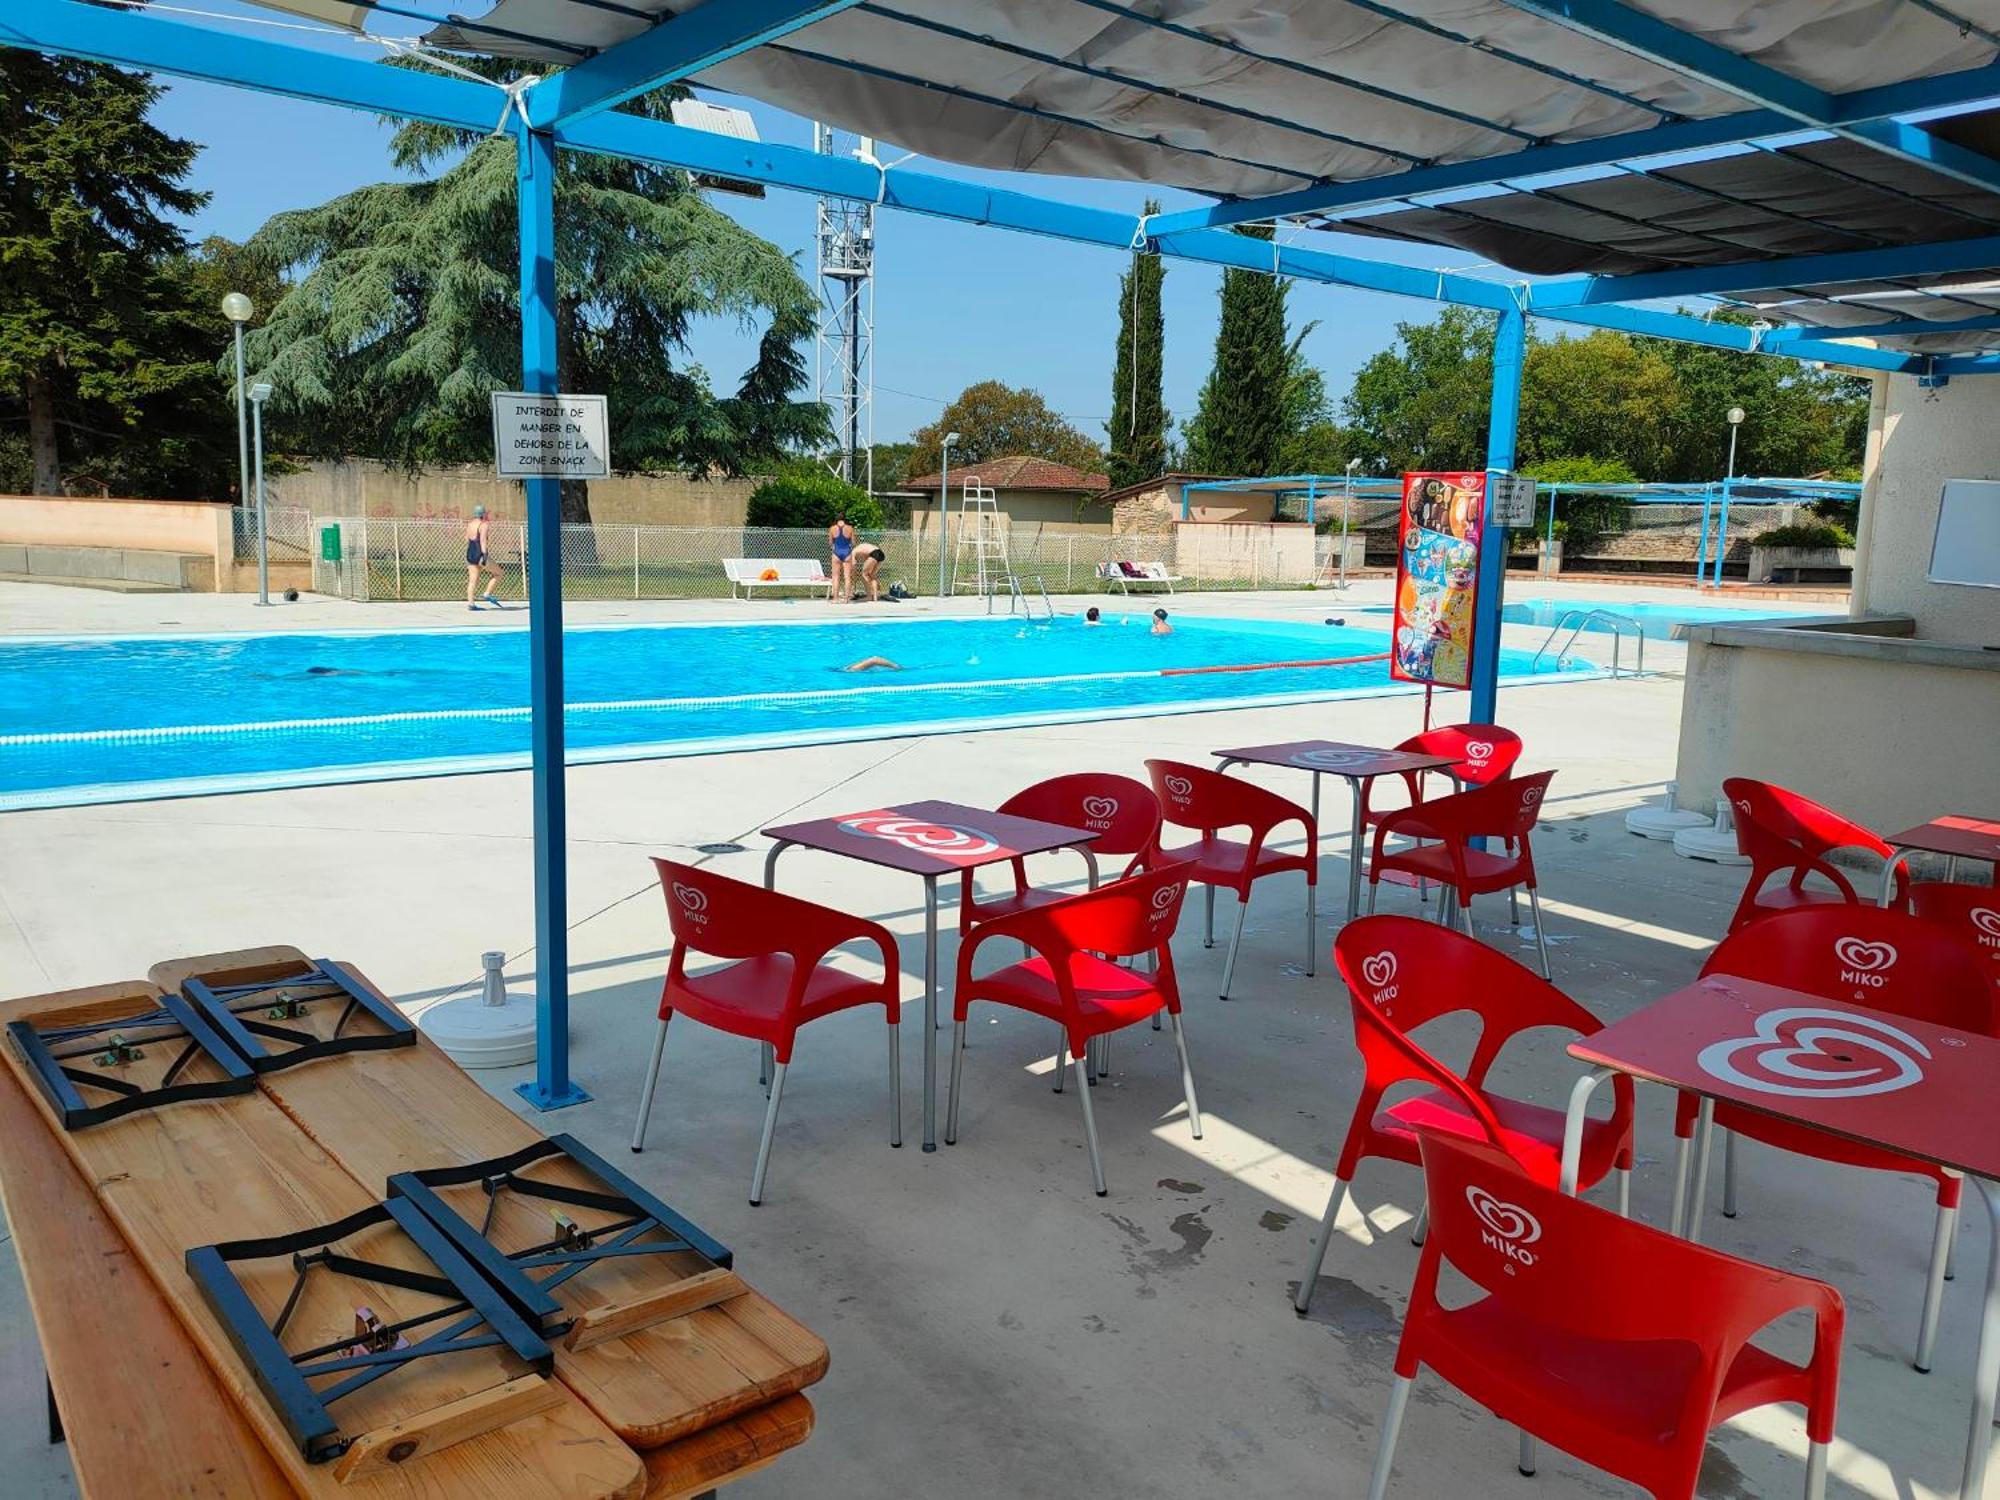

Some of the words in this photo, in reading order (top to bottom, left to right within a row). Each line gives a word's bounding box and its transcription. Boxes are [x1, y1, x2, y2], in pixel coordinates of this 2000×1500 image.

[515, 406, 565, 417] INTERDIT
[570, 408, 585, 418] DE
[519, 423, 561, 433] MANGER
[566, 424, 581, 433] EN
[514, 440, 554, 449] DEHORS
[557, 441, 572, 450] DE
[575, 441, 589, 450] LA
[519, 456, 546, 465] ZONE
[549, 456, 586, 466] SNACK
[1841, 969, 1884, 988] MIKO
[1373, 985, 1398, 1005] MIKO
[1482, 1229, 1534, 1266] MIKO
